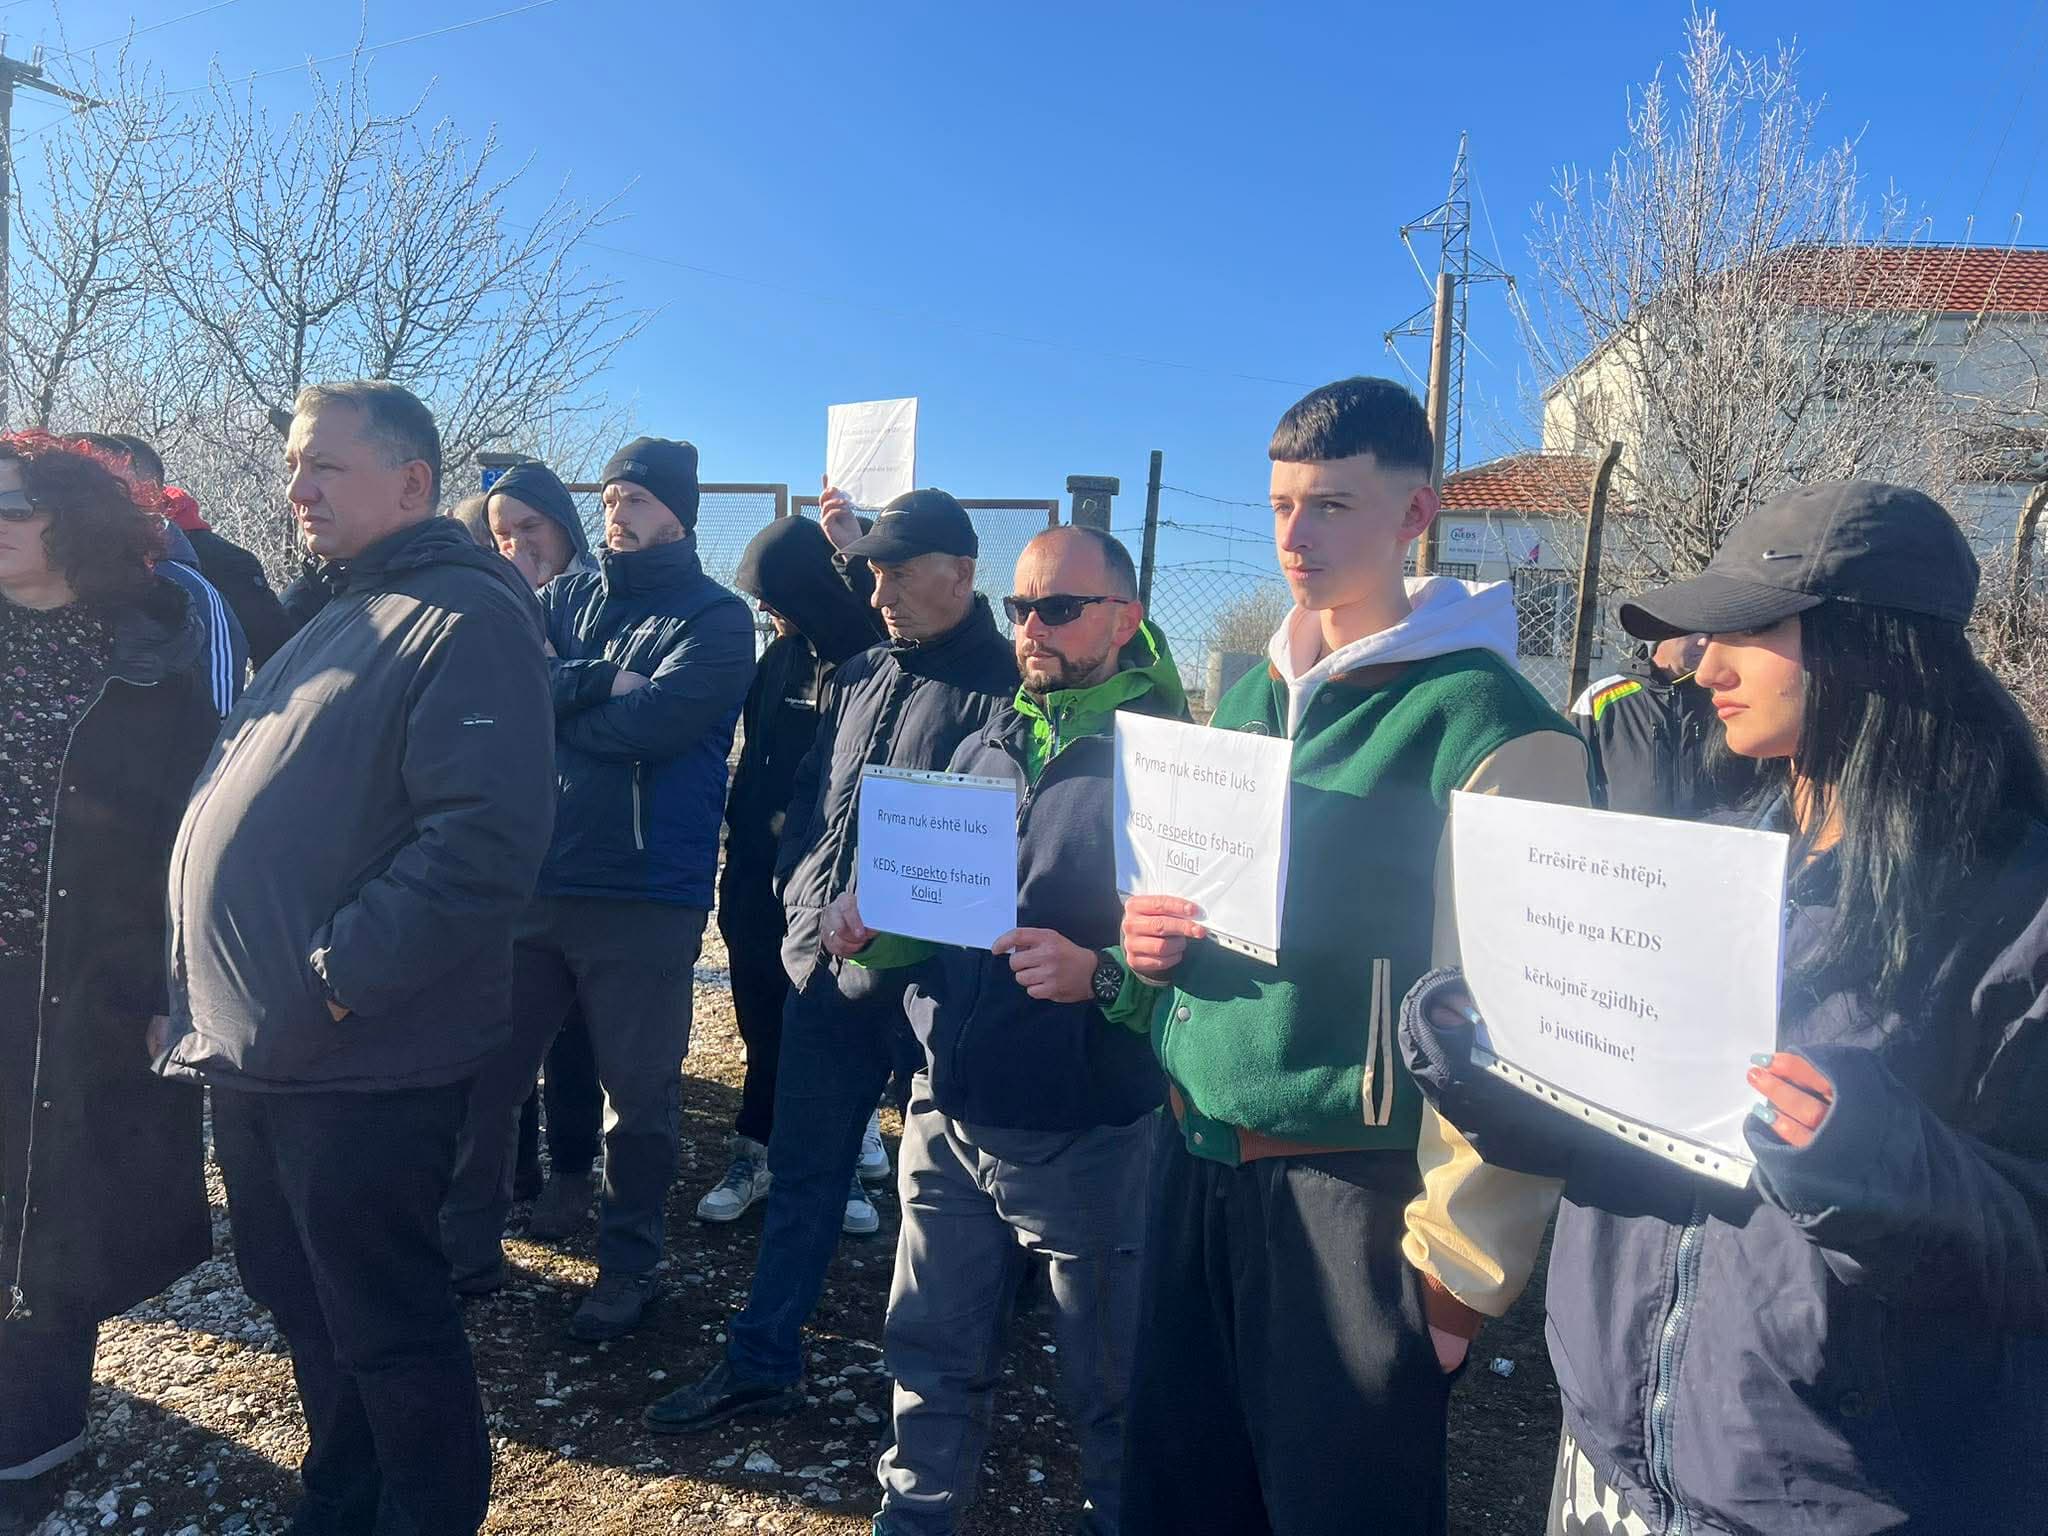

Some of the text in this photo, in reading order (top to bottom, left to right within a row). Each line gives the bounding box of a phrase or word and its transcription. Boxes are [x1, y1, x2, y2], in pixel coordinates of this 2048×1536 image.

[1135, 752, 1256, 793] Rryma nuk është luks
[877, 808, 988, 835] Rryma nuk është luks
[1129, 810, 1255, 860] KEDS, respekto fshatin
[873, 857, 991, 886] KEDS, respekto fshatin
[1528, 847, 1667, 888] Errësirë në shtëpi,
[1526, 907, 1663, 952] heshtje nga KEDS
[1524, 965, 1659, 1021] kërkojmë zgjidhje,
[1539, 1015, 1636, 1063] jo justifikime!
